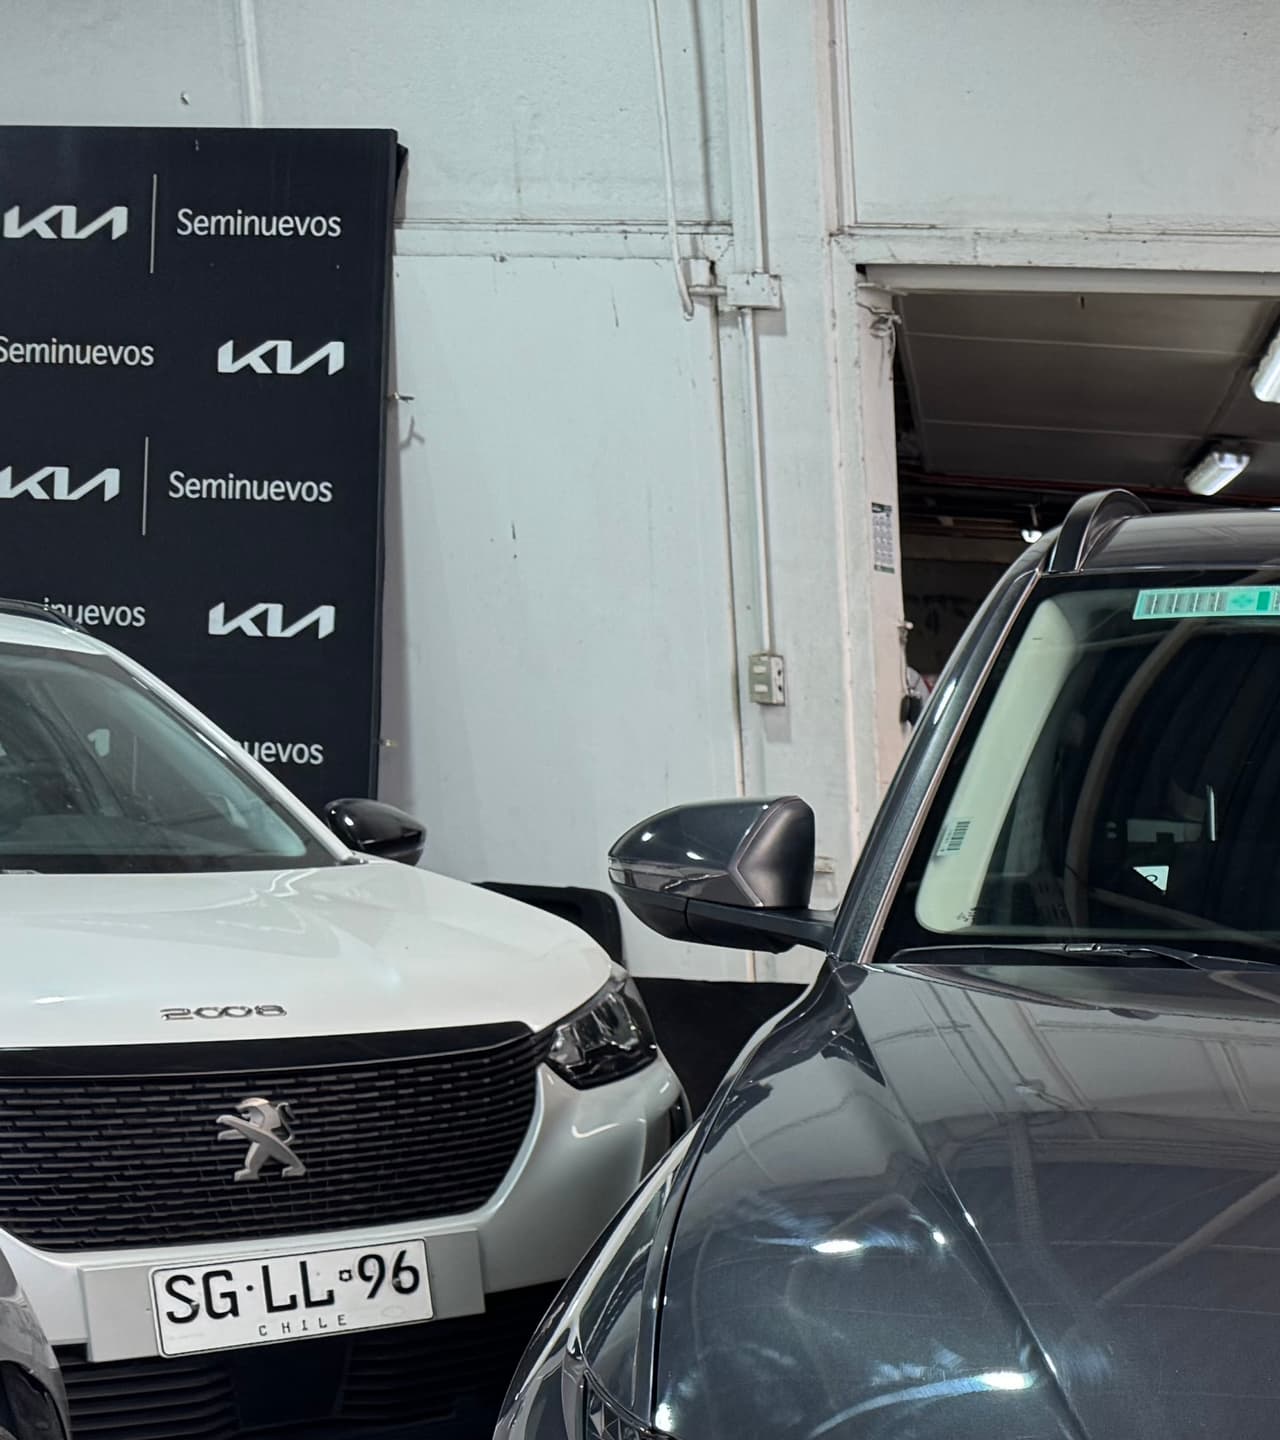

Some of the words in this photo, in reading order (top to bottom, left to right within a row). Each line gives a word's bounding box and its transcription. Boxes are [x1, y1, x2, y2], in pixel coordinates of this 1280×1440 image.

[176, 207, 342, 238] Seminuevos
[168, 471, 333, 503] Seminuevos
[160, 1005, 287, 1020] 2008
[258, 1314, 347, 1337] CHILE
